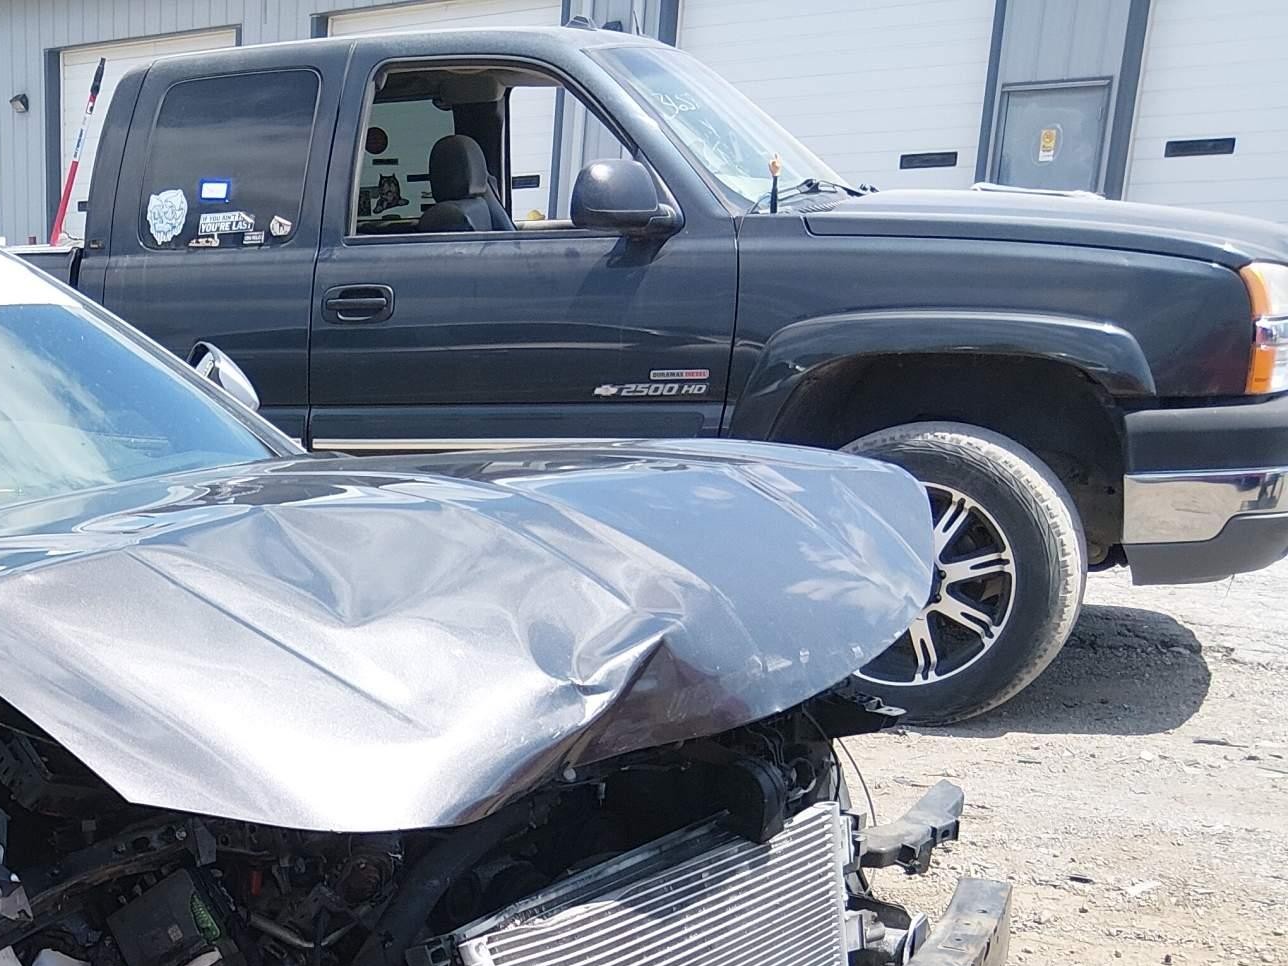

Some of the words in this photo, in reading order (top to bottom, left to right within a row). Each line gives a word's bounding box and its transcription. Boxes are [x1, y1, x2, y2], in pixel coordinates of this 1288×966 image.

[201, 221, 232, 233] YOU'RE
[231, 219, 252, 231] LAST
[620, 384, 679, 396] 2500
[681, 384, 707, 394] HD
